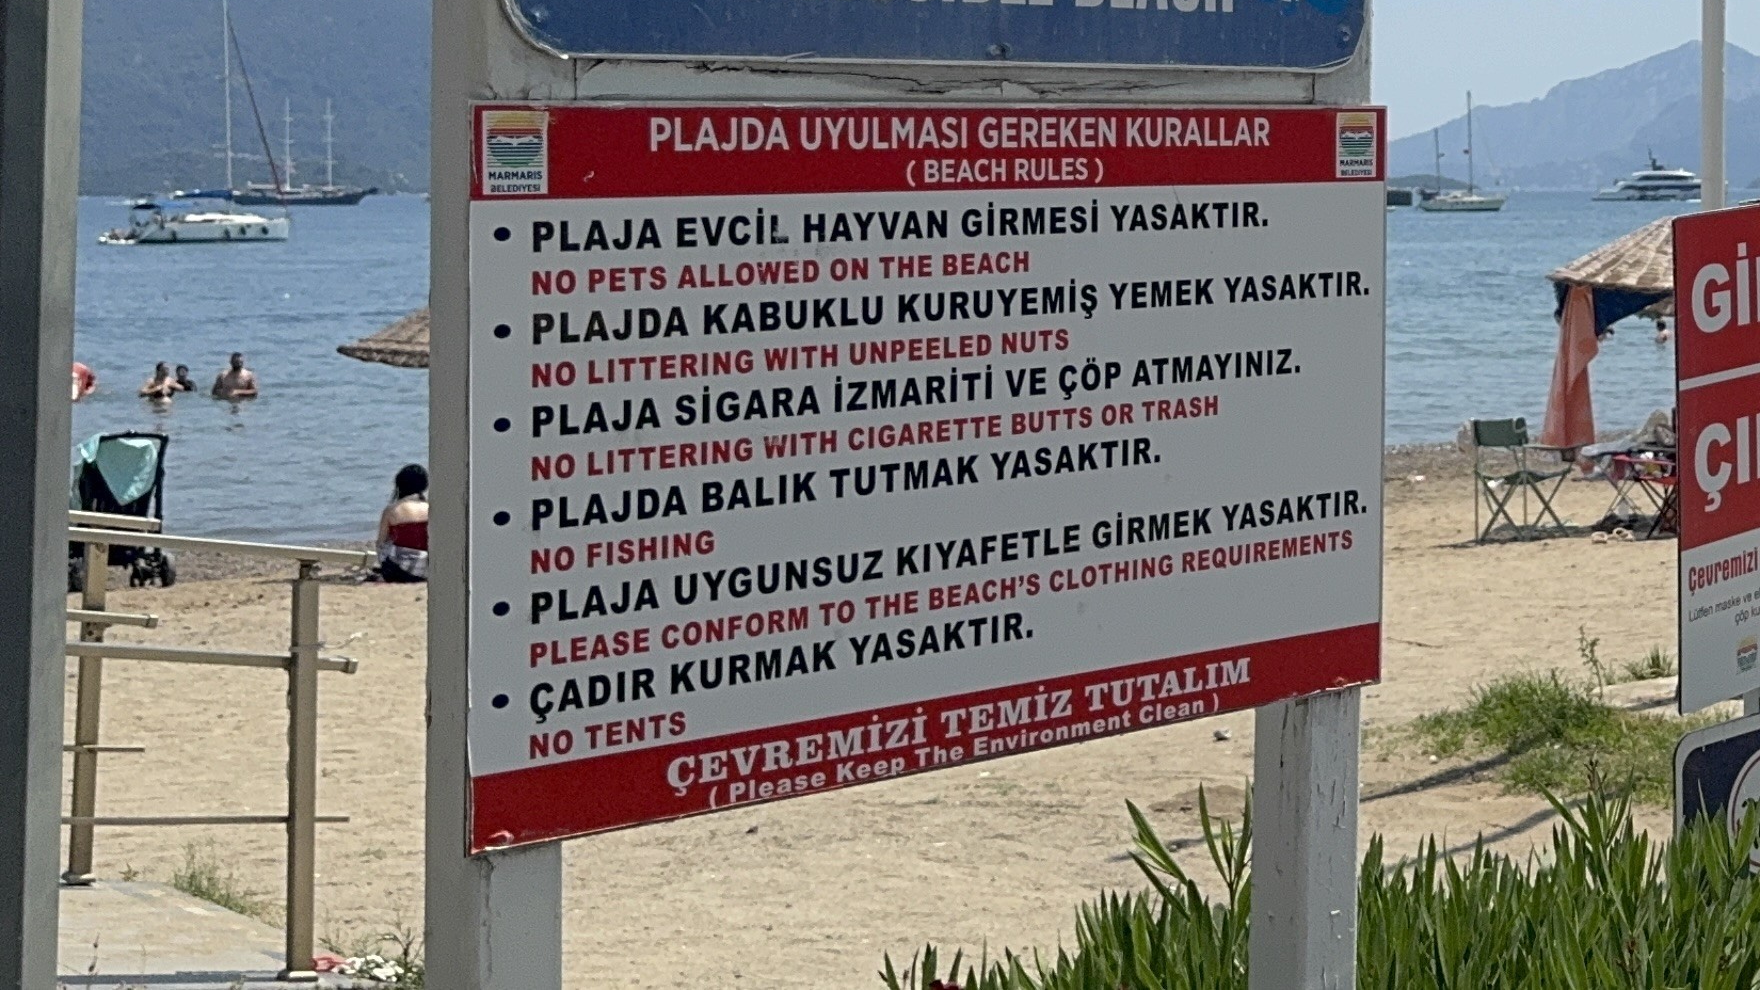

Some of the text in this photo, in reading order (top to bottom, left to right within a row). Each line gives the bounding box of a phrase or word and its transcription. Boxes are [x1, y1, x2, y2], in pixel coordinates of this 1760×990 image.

[650, 116, 1270, 152] PLAJDA UYULMASI GEREKEN KURALLAR
[532, 199, 1269, 253] PLAJA EVCİL HAYVAN GİRMESİ YASAKTIR.
[532, 250, 1030, 295] NO PETS ALLOWED ON THE BEACH
[532, 271, 1369, 345] PLAJDA KABUKLU KURUYEMİŞ YEMEK YASAKTIR.
[532, 329, 1069, 388] NO LITTERING WITH UNPEELED NUTS
[532, 348, 1301, 438] PLAJA SİGARA İZMARİTİ VE ÇÖP ATMAYINIZ.
[531, 395, 1219, 482] NO LITTERING WITH CIGARETTE BUTTS OR TRASH
[532, 437, 1161, 531] PLAJDA BALIK TUTMAK YASAKTIR.
[531, 530, 716, 575] NO FISHING
[531, 489, 1367, 625] PLAJA UYGUNSUZ KIYAFETLE GİRMEK YASAKTIR.
[1689, 547, 1758, 597] Çevremizi
[530, 628, 650, 668] PLEASE
[661, 607, 809, 649] CONFORM
[819, 600, 856, 626] TO
[865, 590, 920, 619] THE
[1049, 554, 1173, 593] CLOTHING
[1181, 530, 1353, 573] REQUIREMENTS
[530, 612, 1033, 723] ÇADIR KURMAK YASAKTIR.
[530, 712, 687, 760] NO TENTS
[667, 656, 1251, 796] ÇEVREMİZİ TEMİZ TUTALIM
[836, 755, 906, 784] Keep
[915, 742, 964, 768] The
[973, 713, 1131, 757] Environment
